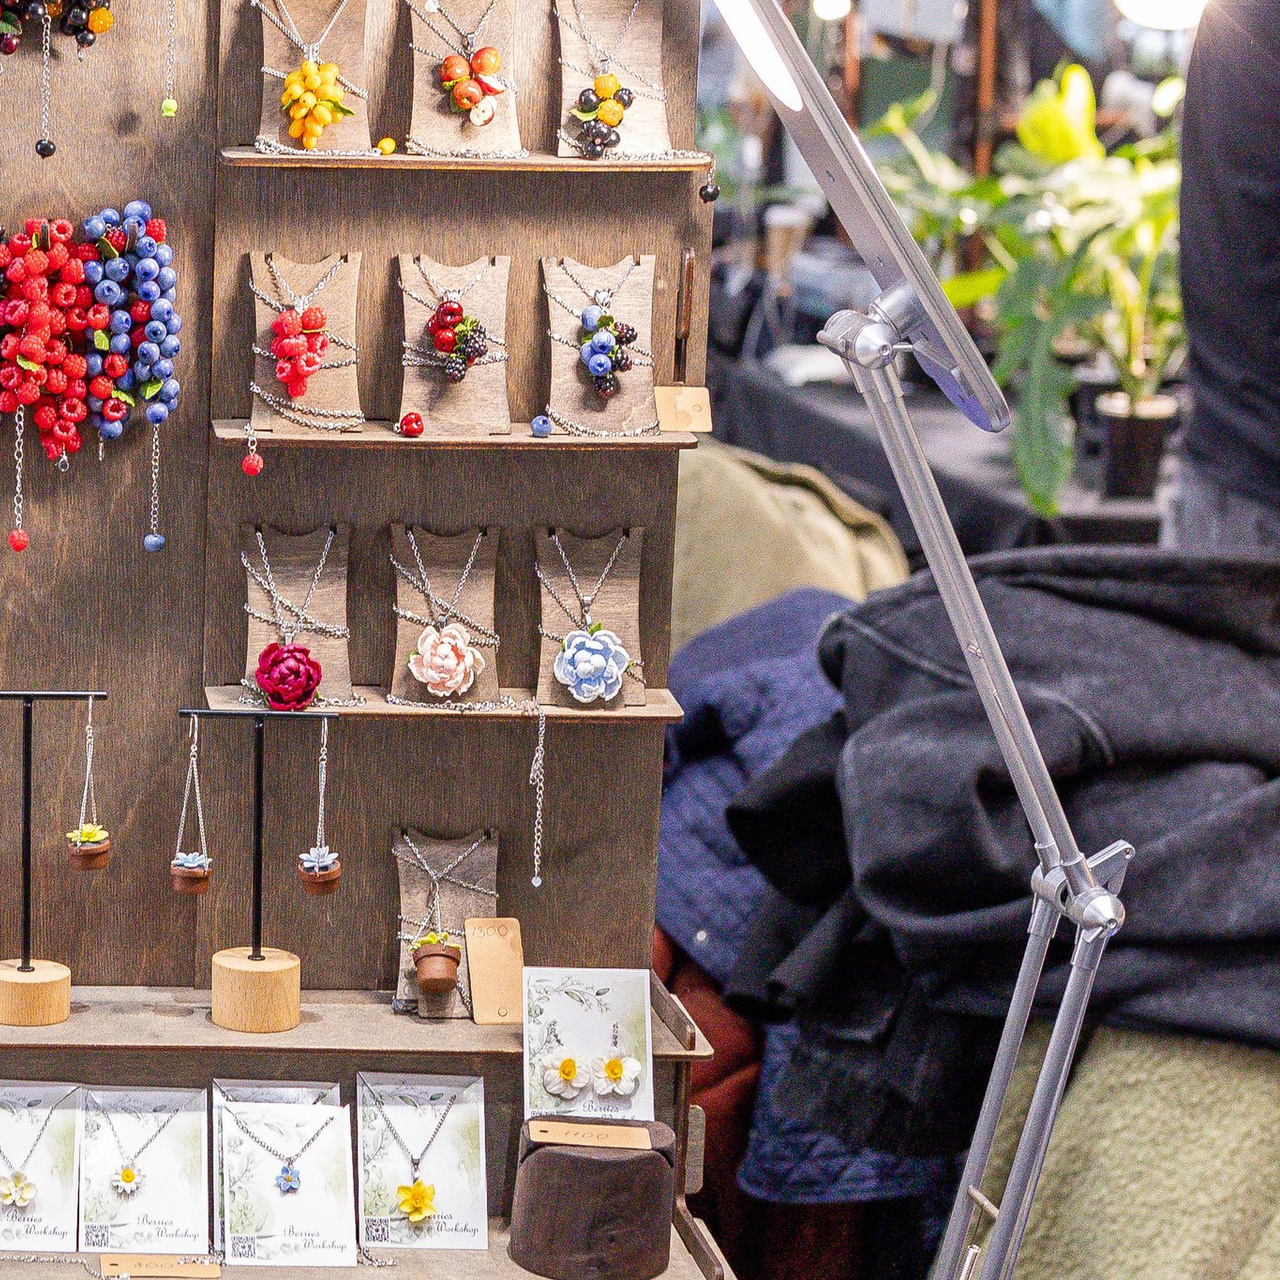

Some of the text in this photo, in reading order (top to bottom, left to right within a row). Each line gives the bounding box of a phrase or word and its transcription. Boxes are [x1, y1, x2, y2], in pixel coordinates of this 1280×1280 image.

[472, 924, 509, 939] 1300
[582, 1100, 620, 1113] Berries
[6, 1208, 43, 1224] Berries
[136, 1213, 174, 1226] Berries
[423, 1211, 454, 1221] erries
[24, 1223, 68, 1240] Workshop
[155, 1226, 200, 1240] Workshop
[283, 1225, 321, 1238] Berries
[434, 1220, 480, 1237] Workshop
[302, 1238, 347, 1253] Workshop
